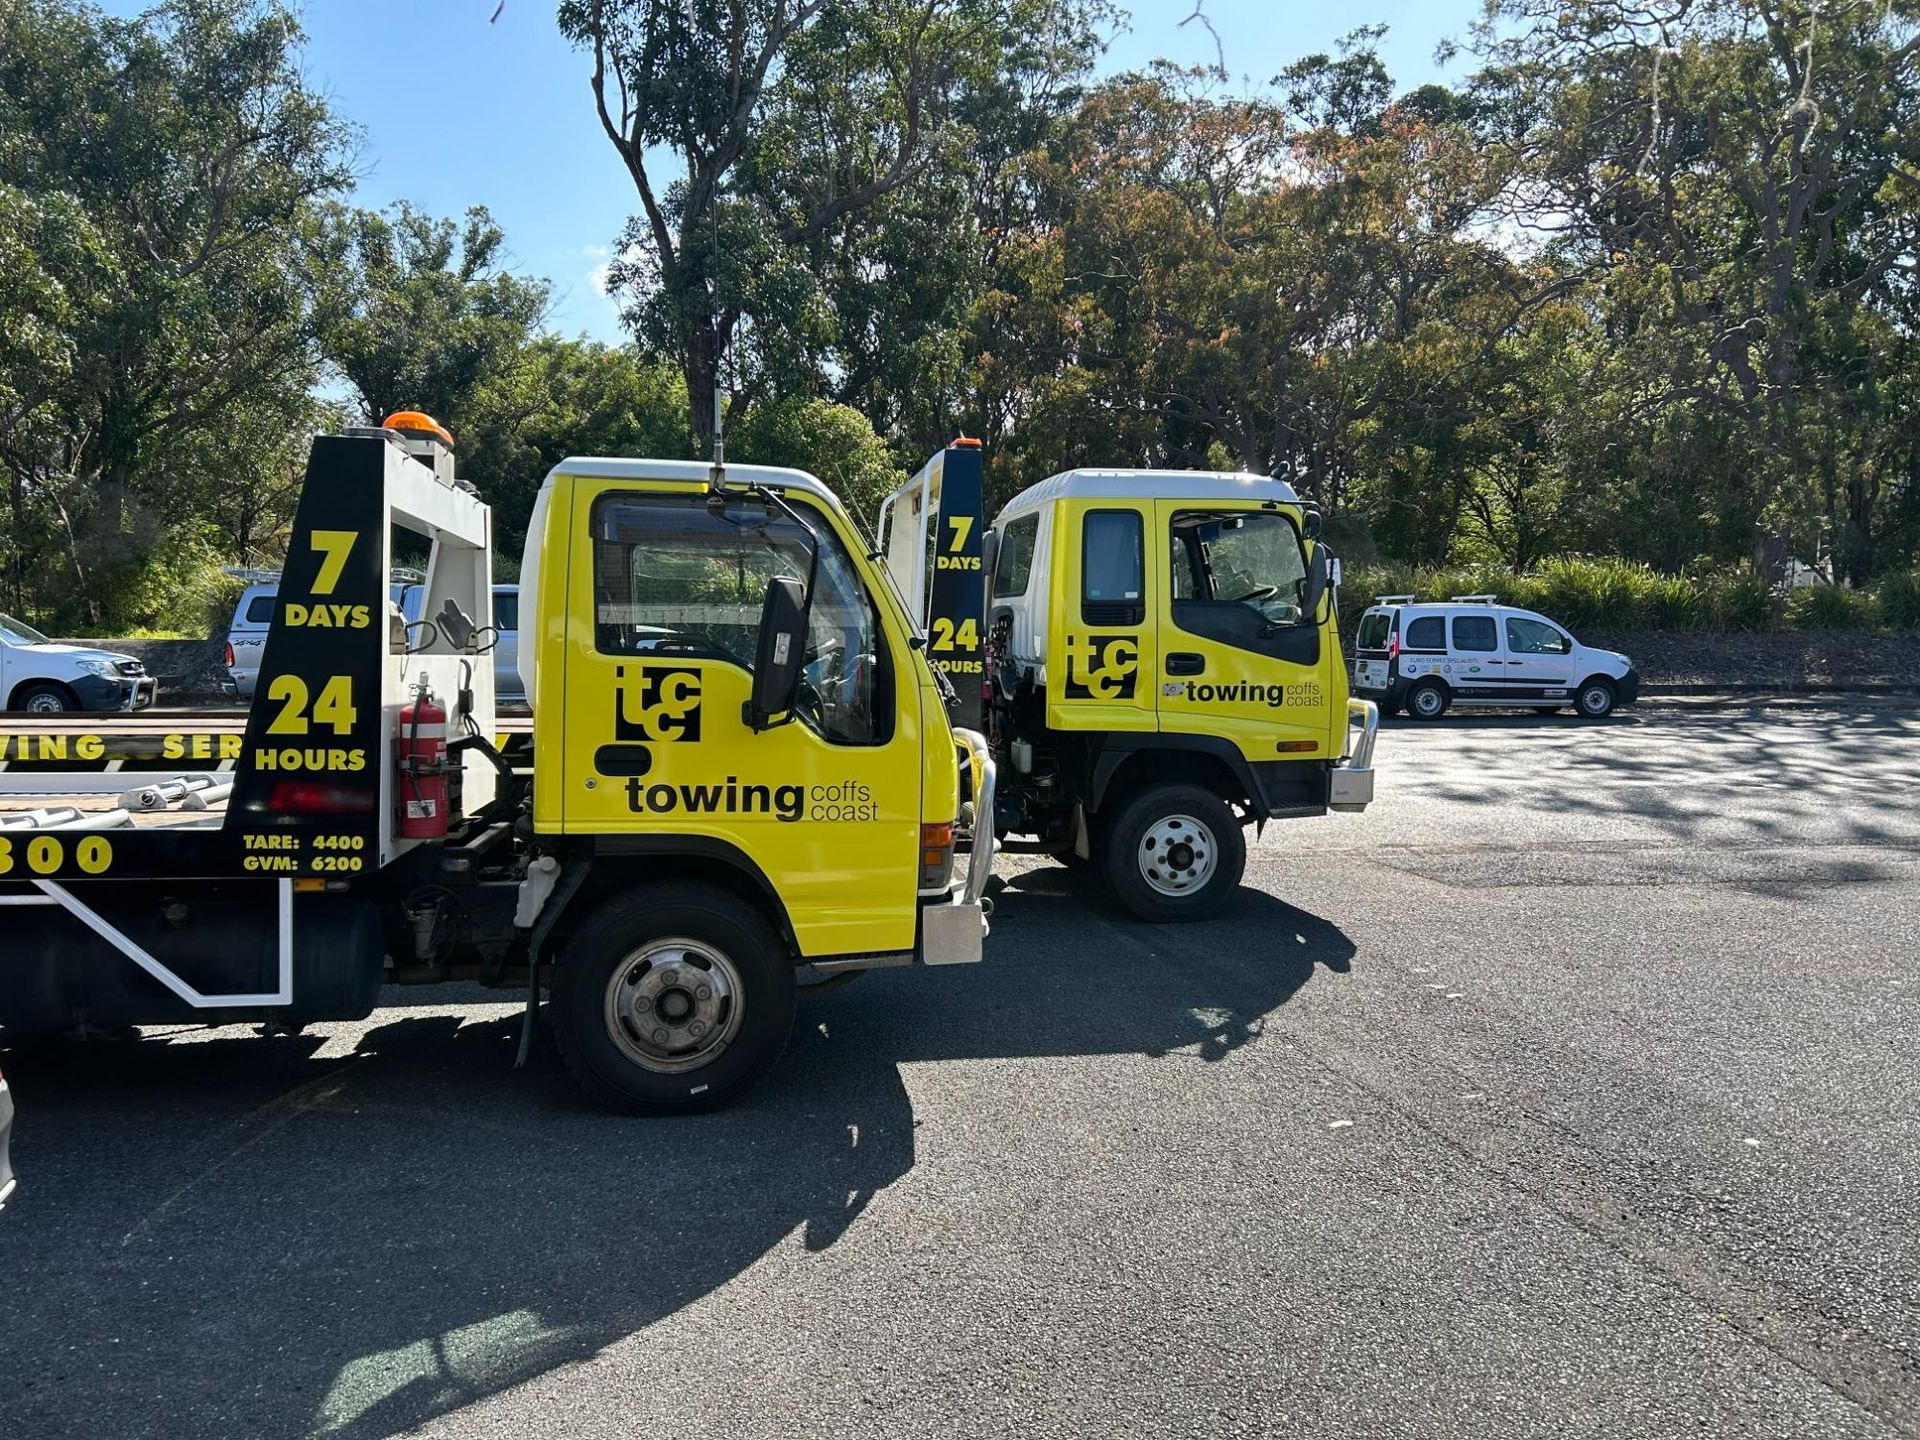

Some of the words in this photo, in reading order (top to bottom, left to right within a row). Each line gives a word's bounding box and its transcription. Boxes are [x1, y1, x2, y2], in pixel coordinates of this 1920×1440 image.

[949, 516, 973, 552] 7
[310, 530, 359, 595] 7
[937, 556, 981, 570] DAYS
[285, 603, 370, 629] DAYS
[932, 617, 979, 652] 24
[1186, 680, 1284, 707] towing
[1286, 682, 1320, 695] coffs
[265, 674, 357, 735] 24
[1286, 695, 1323, 707] coast
[0, 734, 106, 761] ING
[255, 748, 366, 771] HOURS
[625, 776, 804, 822] towing
[810, 780, 871, 802] coffs
[810, 801, 879, 822] coast
[243, 835, 300, 850] TARE:
[312, 835, 364, 850] 4400
[243, 856, 298, 871] GVM:
[311, 856, 363, 871] 6200
